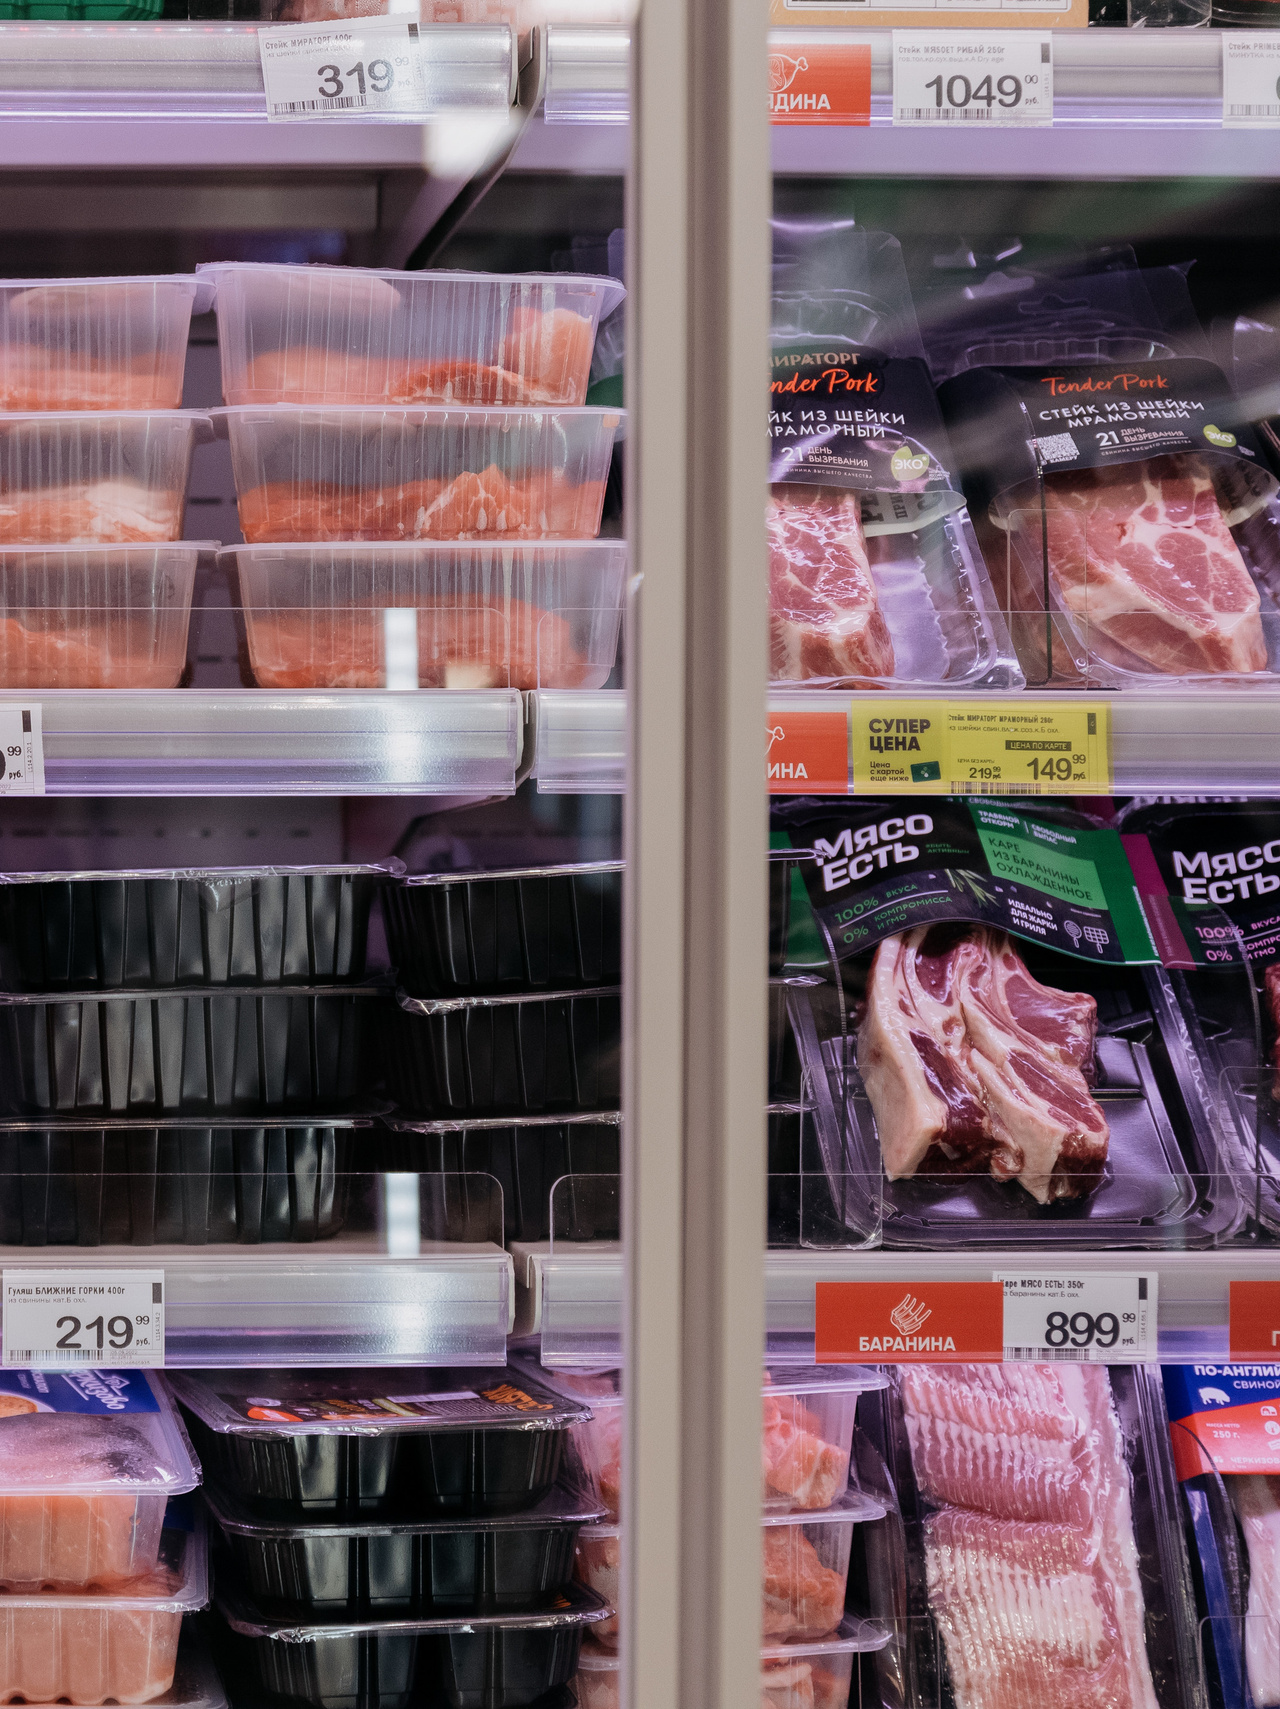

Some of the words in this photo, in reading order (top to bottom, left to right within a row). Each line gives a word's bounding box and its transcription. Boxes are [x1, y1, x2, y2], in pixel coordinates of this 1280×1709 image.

[265, 40, 288, 50] Стейк
[291, 36, 331, 48] МИРАТОРГ
[957, 45, 984, 53] РИБАЙ
[318, 59, 393, 98] 319
[925, 75, 1022, 107] 1049
[1025, 75, 1038, 84] 00
[822, 369, 878, 393] Pork
[1041, 377, 1112, 396] Tender
[1114, 374, 1169, 391] Pork
[802, 411, 827, 421] ИЗ
[836, 409, 905, 424] ШЕЙКИ
[1039, 404, 1099, 421] СТЕЙК
[1105, 402, 1131, 411] ИЗ
[1136, 399, 1205, 410] ШЕЙКИ
[1068, 409, 1190, 429] МРАМОРНЫЙ
[1096, 431, 1119, 447] 21
[1121, 427, 1145, 436] ДЕНЬ
[1124, 430, 1184, 442] ВЫЗРЕВАНИЯ
[781, 447, 803, 461] 21
[809, 455, 868, 467] ВЫЗРЕВАНИЯ
[869, 719, 931, 733] СУПЕР
[7, 746, 21, 756] 99
[870, 736, 920, 753] ЦЕНА
[969, 767, 991, 779] 219
[1027, 757, 1071, 781] 149
[1073, 754, 1086, 764] 99
[978, 810, 1020, 824] ТРАВЯНОЙ
[981, 817, 1014, 828] ОТКОРМ
[814, 814, 933, 867] МЯСО
[1031, 824, 1077, 843] СВОБОДНЫЙ
[1033, 831, 1058, 844] ВЫПАС
[988, 838, 1020, 852] КАРЕ
[823, 842, 919, 892] ЕСТЬ
[993, 850, 1010, 861] ИЗ
[1013, 856, 1079, 886] БАРАНИНЫ
[996, 863, 1093, 900] ОХЛАЖДЕННОЕ
[1182, 873, 1280, 904] ЕСТЬ
[835, 897, 878, 923] 100%
[886, 884, 918, 898] ВКУСА
[875, 896, 952, 922] КОМПРОМИССА
[1008, 899, 1053, 920] ИДЕАЛЬНО
[843, 925, 869, 943] 0%
[886, 914, 907, 925] ГМО
[1011, 908, 1027, 920] ДЛЯ
[1029, 914, 1058, 930] ЖАРКИ
[1021, 920, 1046, 935] ГРИЛЯ
[1195, 925, 1244, 938] 100%
[1206, 950, 1233, 961] 0%
[1254, 947, 1276, 959] ГМО
[9, 1287, 32, 1295] Гуляш
[1021, 1280, 1042, 1288] МЯСО
[1068, 1281, 1085, 1289] 350г
[56, 1315, 133, 1349] 219
[136, 1316, 149, 1325] 99
[1045, 1312, 1119, 1348] 899
[1122, 1313, 1136, 1323] 99
[859, 1336, 955, 1353] БАРАНИНА
